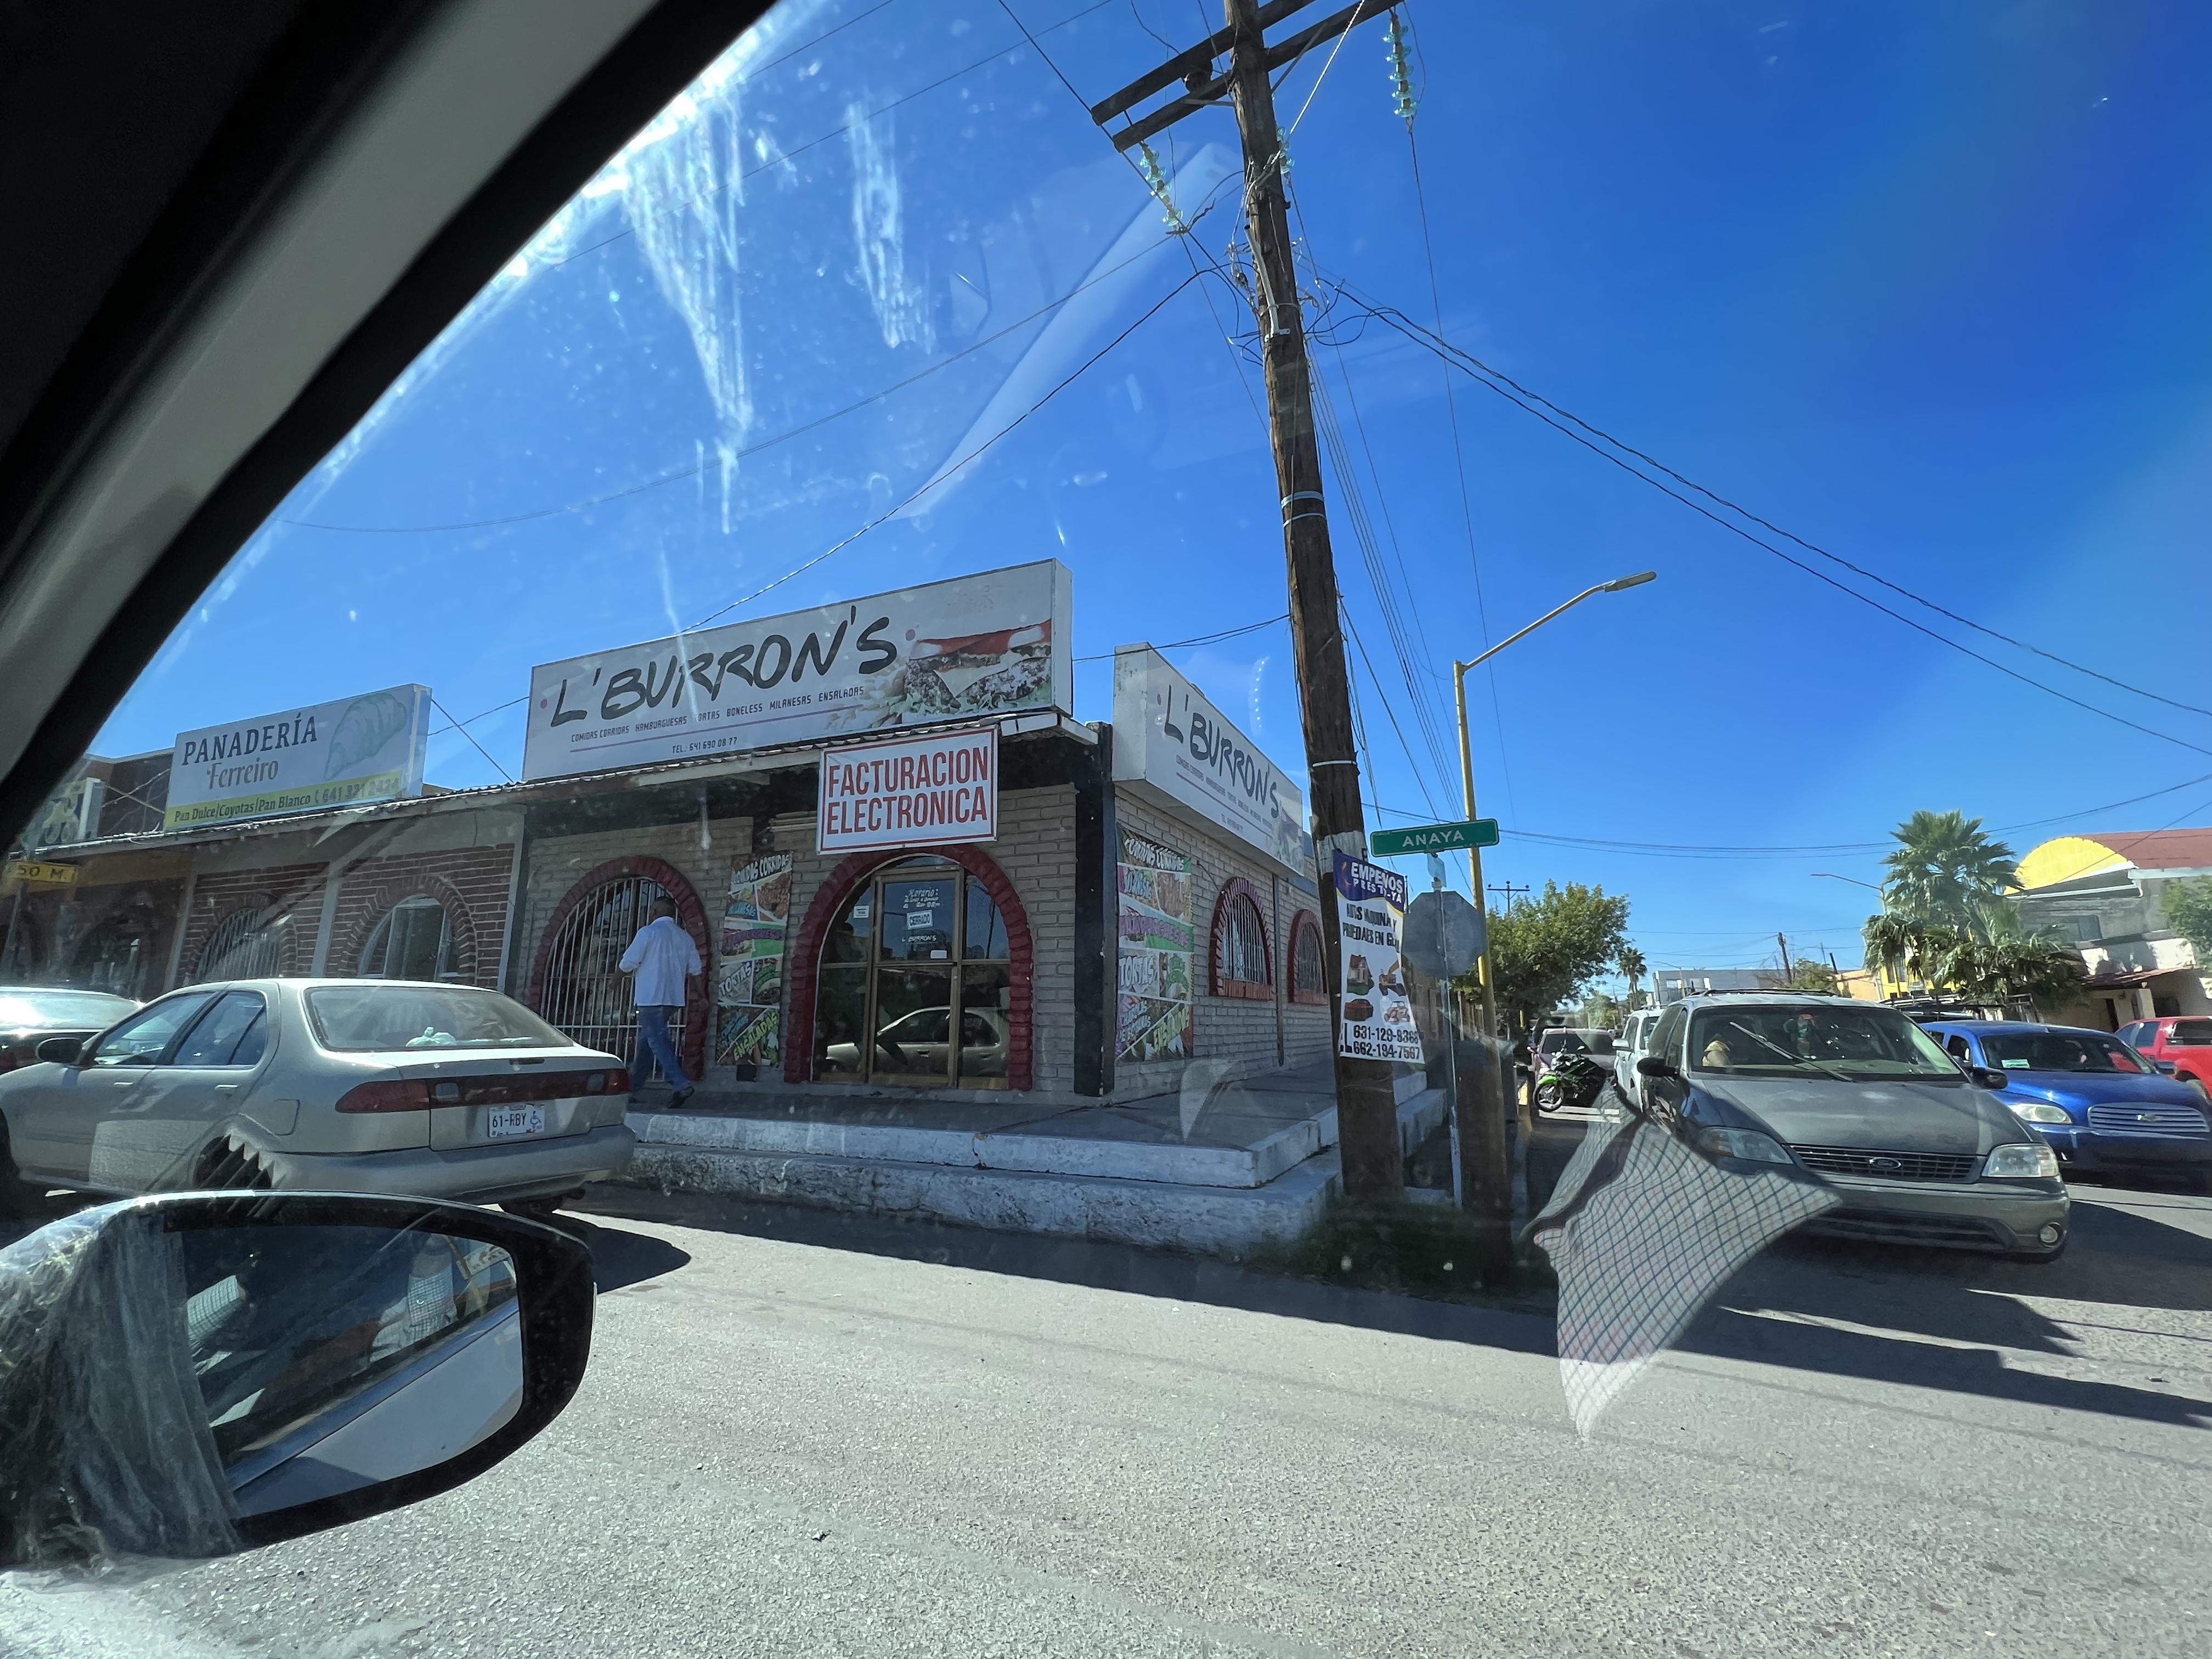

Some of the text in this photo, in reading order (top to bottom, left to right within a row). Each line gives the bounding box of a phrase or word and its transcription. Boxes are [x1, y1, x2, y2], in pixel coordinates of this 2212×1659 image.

[551, 606, 897, 727] L'BURRON'S
[571, 686, 864, 743] COMIDAS CORRIDAS HAMBURGUESAS ORTAS BONELESS MILANESAS ENSALADAS
[182, 712, 317, 766] PANADERÍA
[689, 742, 701, 752] 641
[703, 740, 715, 749] 690
[717, 738, 726, 748] 08
[729, 736, 737, 746] 77
[1164, 684, 1279, 819] L'BURRON'S
[206, 759, 279, 790] Ferreiro
[828, 746, 988, 798] FACTURACION
[174, 810, 190, 822] Pan
[278, 794, 311, 809] Blanco
[322, 786, 342, 803] 641
[827, 786, 988, 835] ELECTRONICA
[1402, 830, 1465, 847] ANAYA
[1351, 861, 1403, 894] EMPEÑOS
[718, 961, 752, 996] TORTAS
[1119, 955, 1155, 988] TORTAS
[733, 1012, 778, 1062] ENSALADAS
[492, 1113, 527, 1128] 61-RBY
